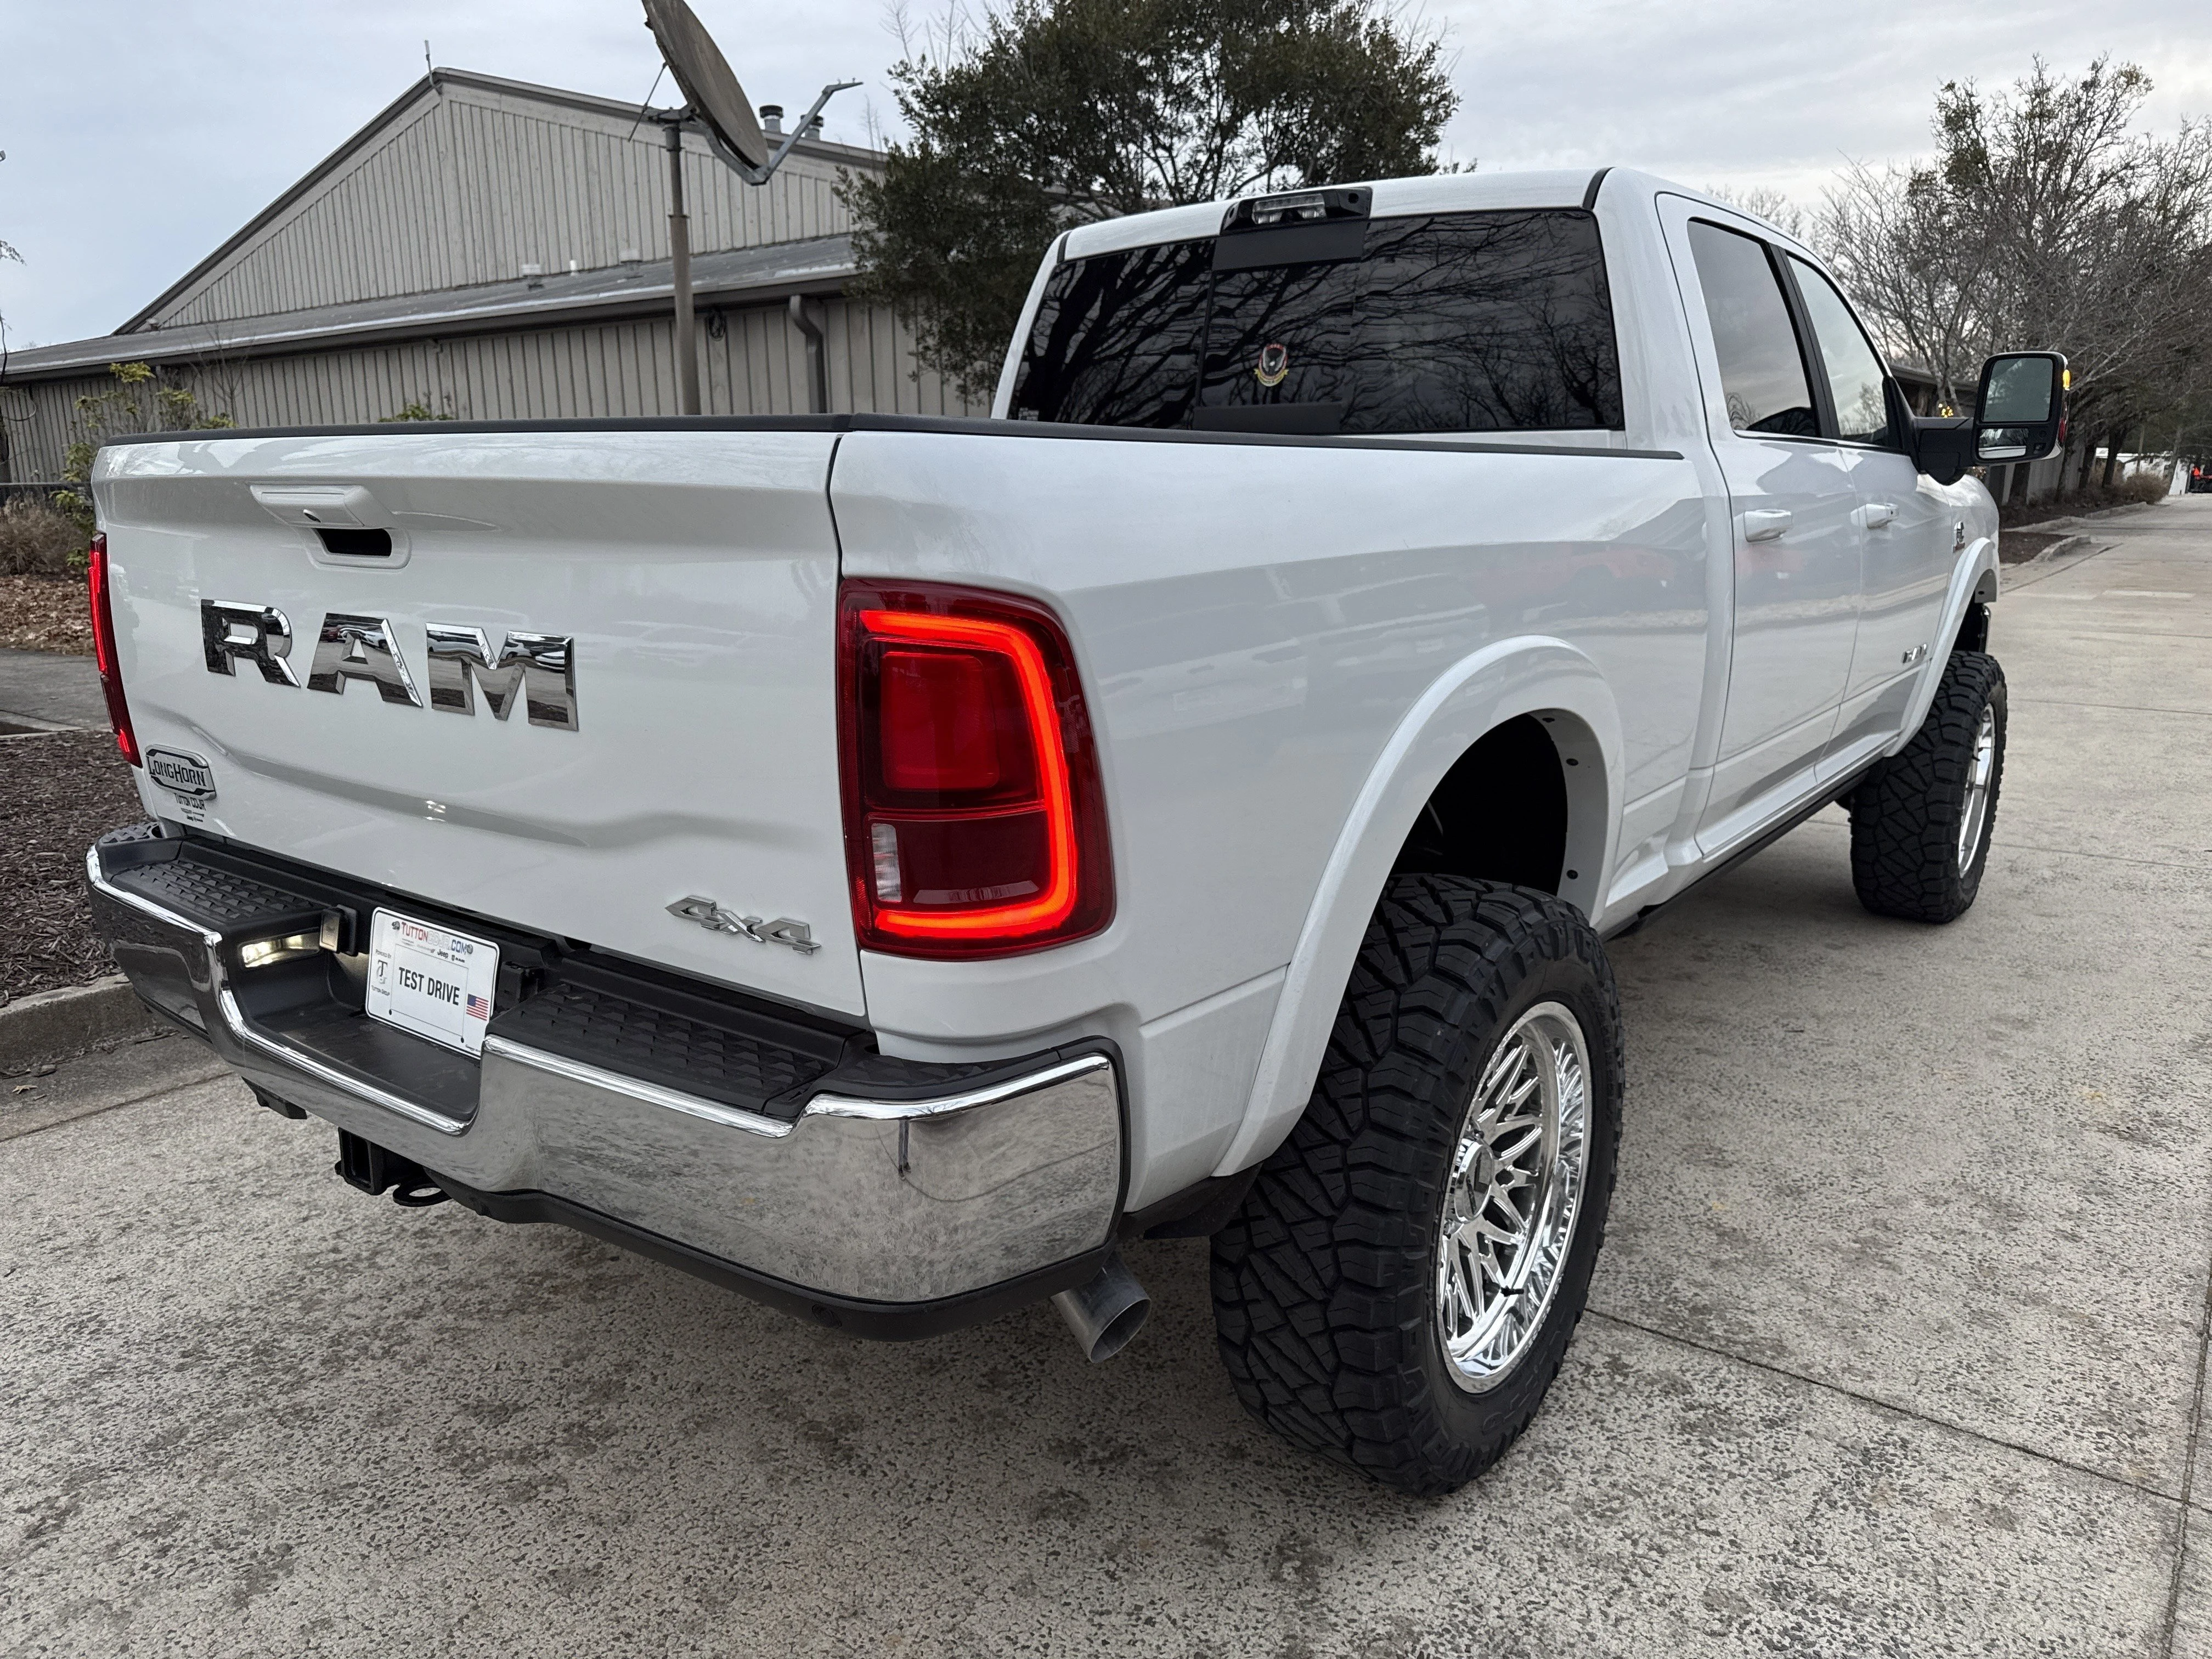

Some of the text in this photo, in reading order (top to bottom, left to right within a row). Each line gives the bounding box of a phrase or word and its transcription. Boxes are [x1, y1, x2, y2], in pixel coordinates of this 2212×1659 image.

[201, 599, 579, 731] RAM
[146, 755, 207, 787] LONGHORN
[398, 967, 460, 1006] TEST DRIVE
